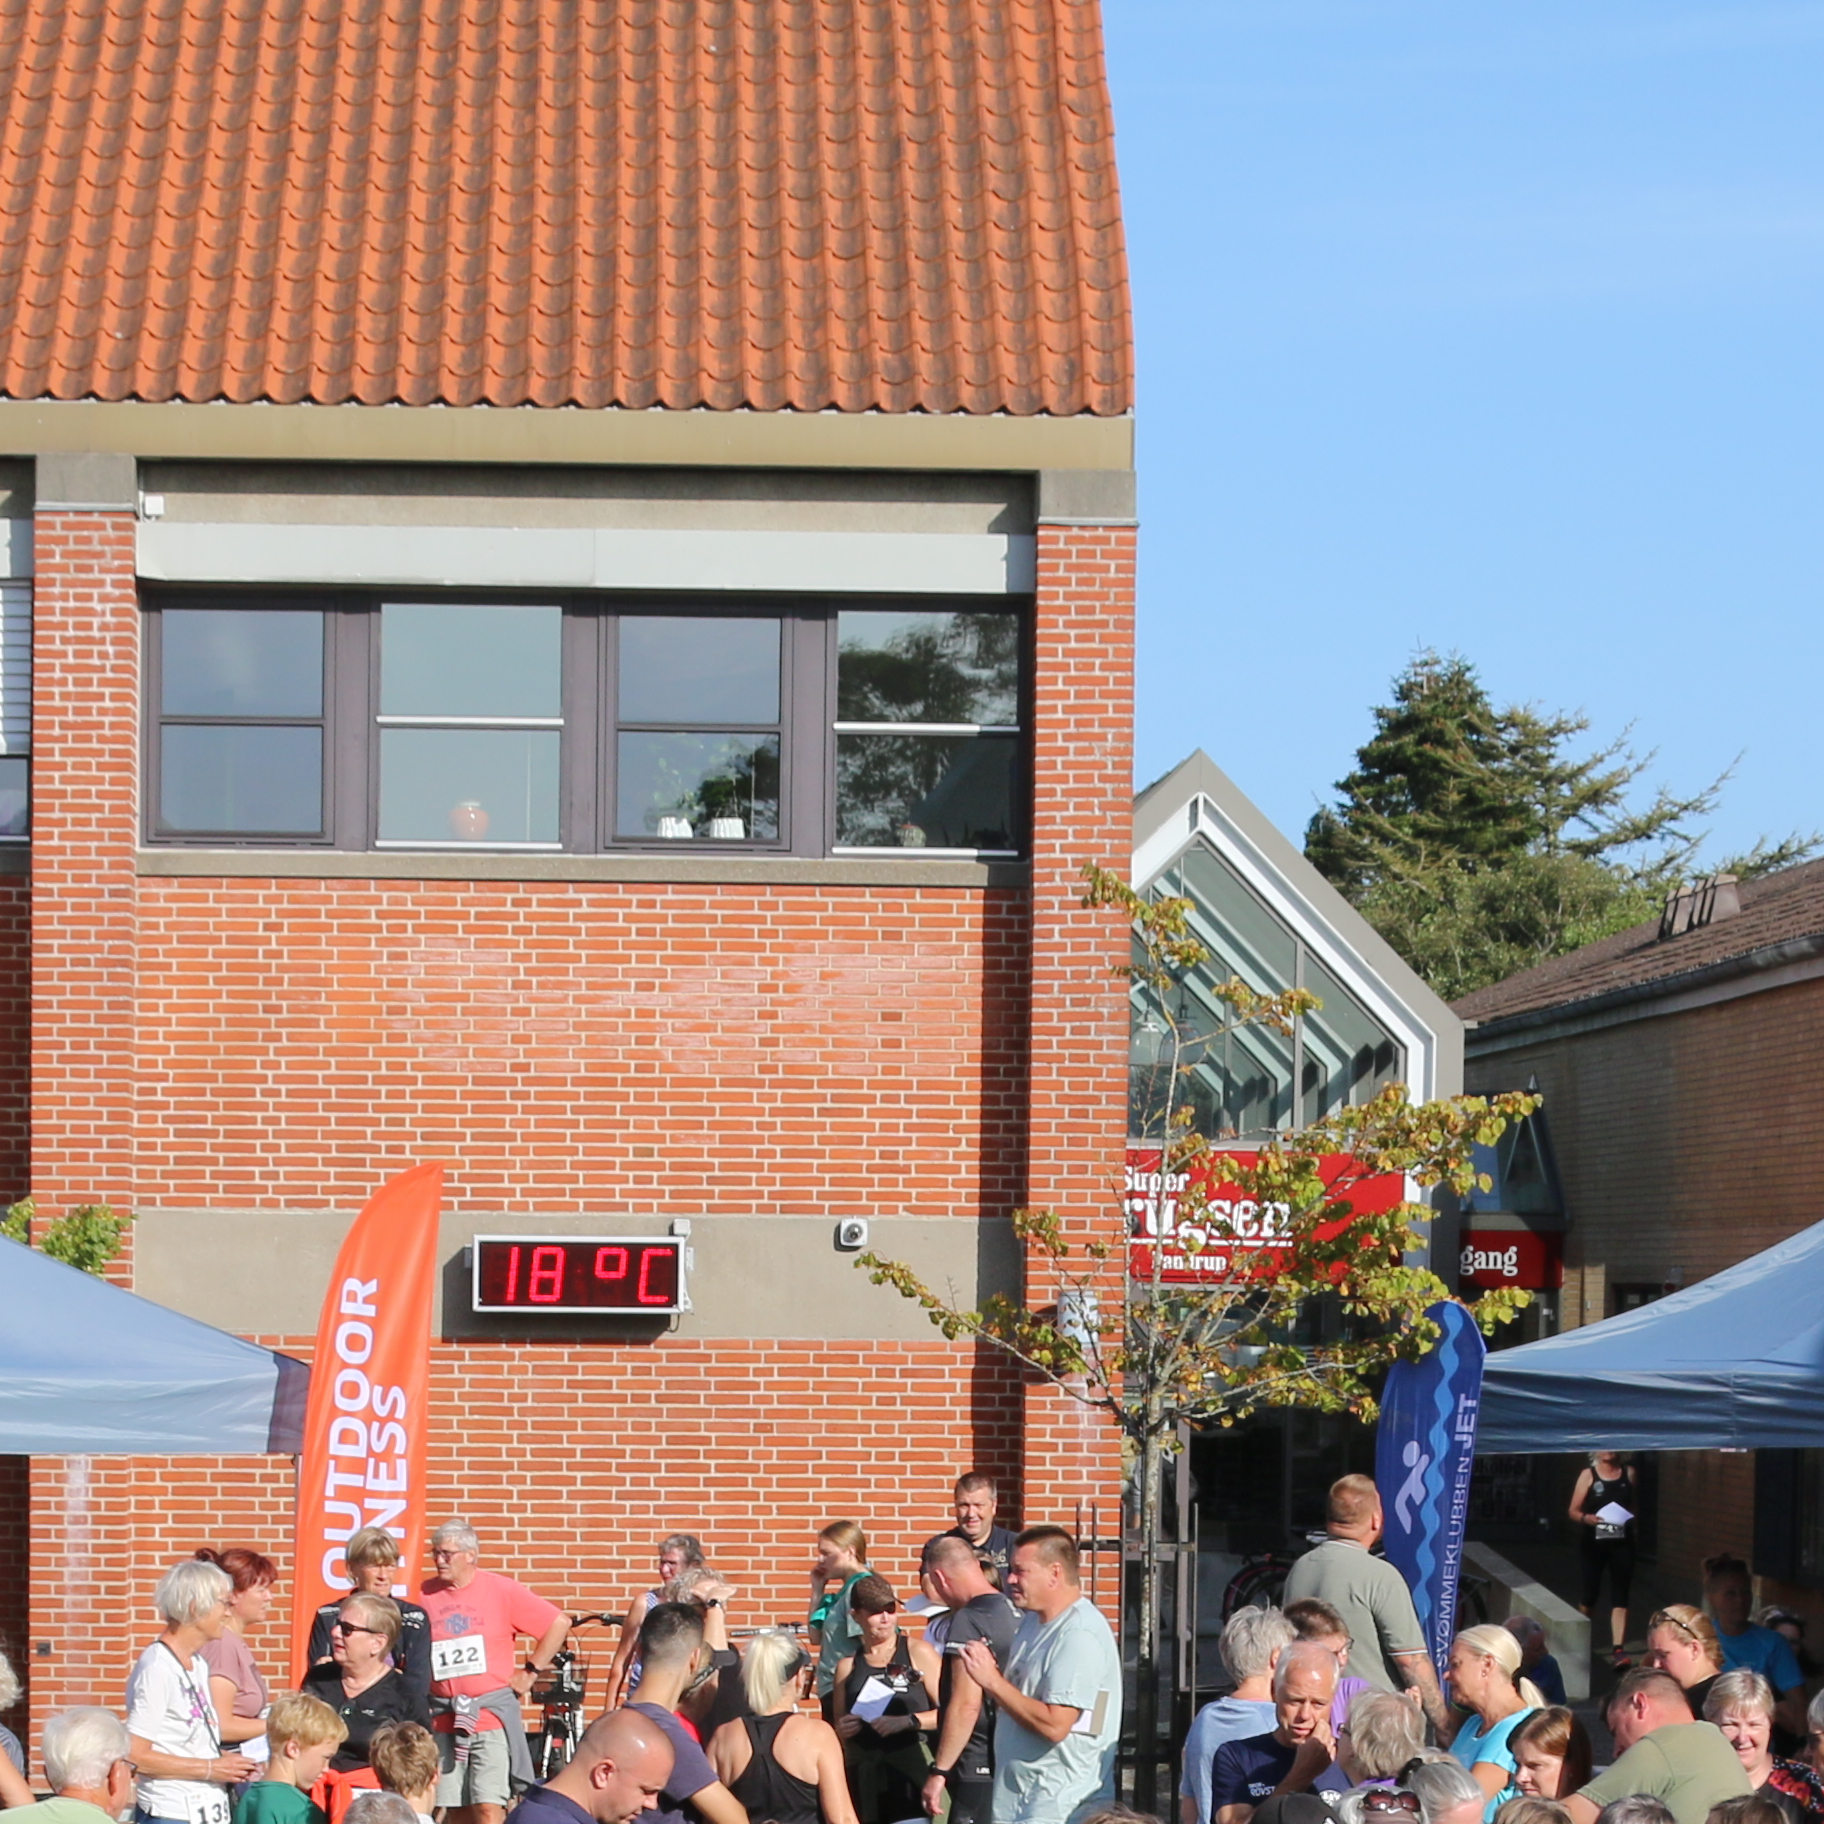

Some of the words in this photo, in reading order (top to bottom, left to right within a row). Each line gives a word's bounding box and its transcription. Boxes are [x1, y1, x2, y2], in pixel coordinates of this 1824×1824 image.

[506, 1246, 565, 1303] 18
[321, 1277, 378, 1592] OUTDOOR
[1453, 1394, 1478, 1450] JET
[1436, 1455, 1471, 1668] SVØMMEKLUBBEN
[438, 1646, 479, 1668] 122
